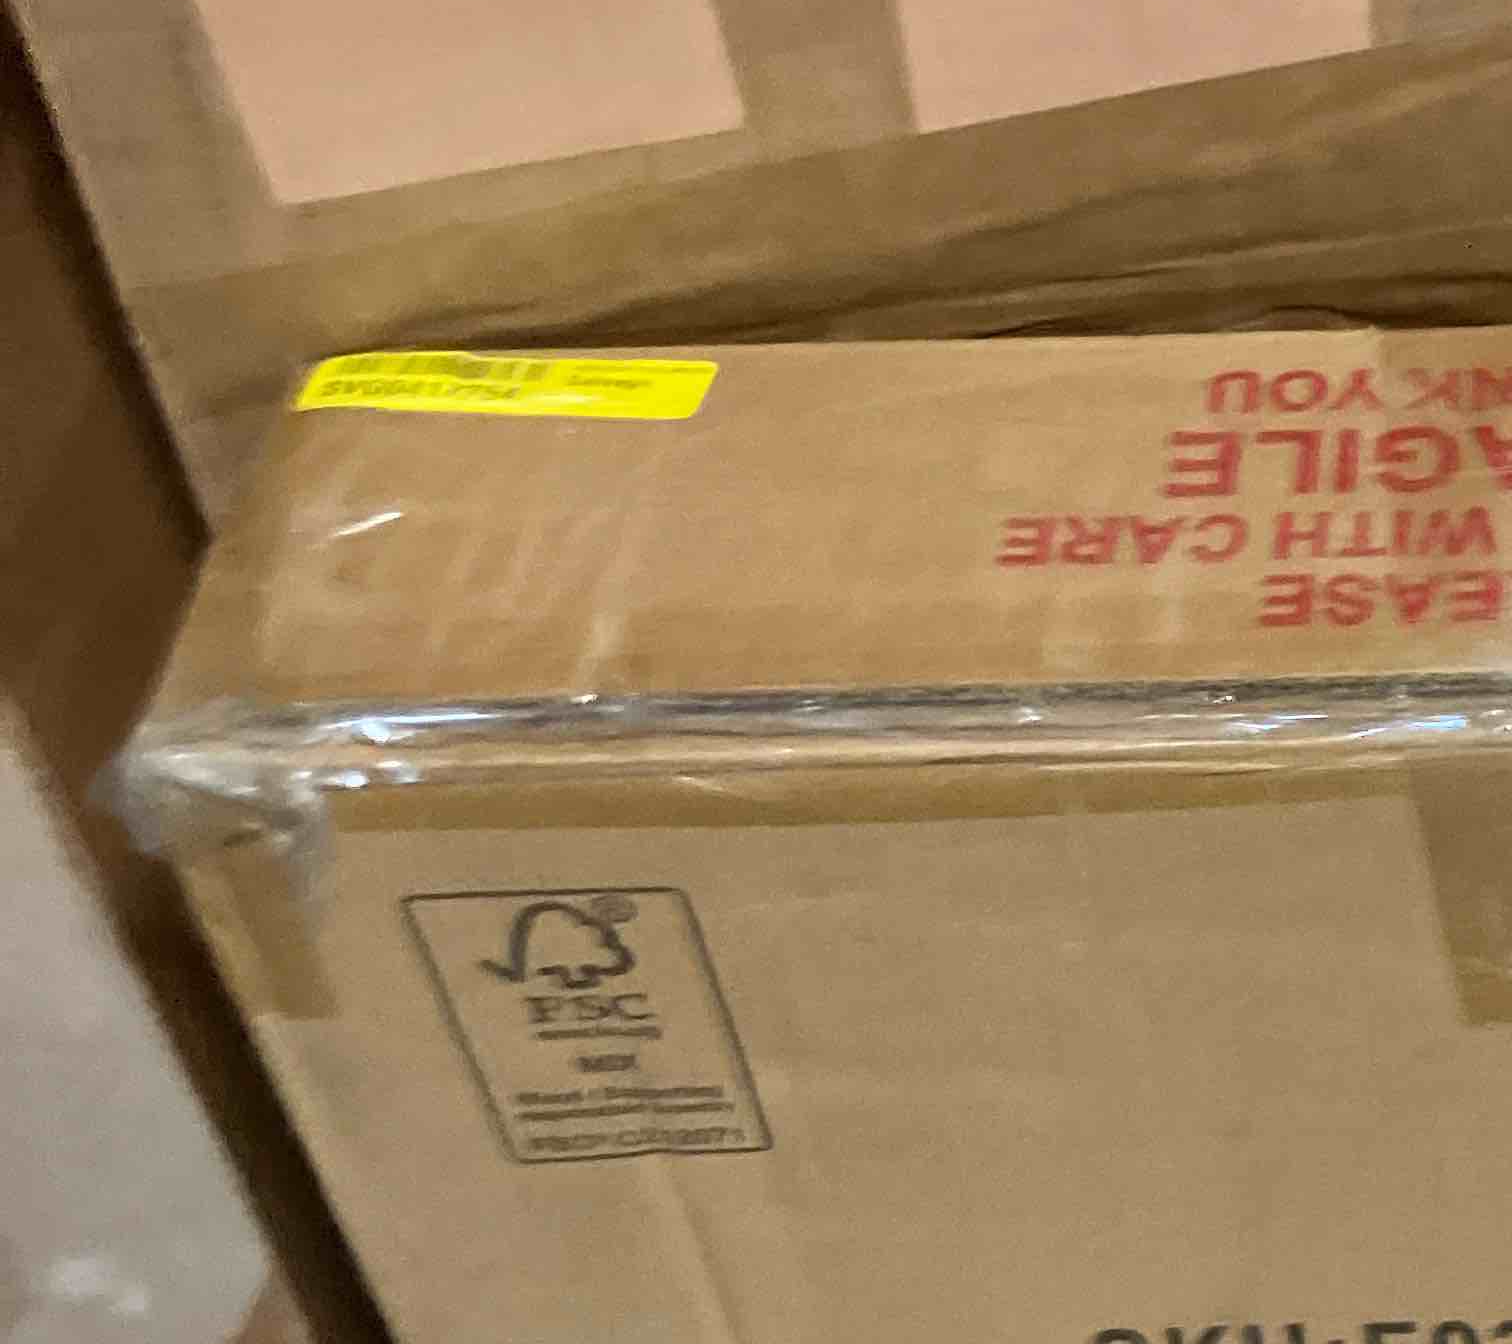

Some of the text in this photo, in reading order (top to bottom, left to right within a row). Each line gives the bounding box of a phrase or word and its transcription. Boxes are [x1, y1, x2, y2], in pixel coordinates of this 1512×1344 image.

[1206, 367, 1384, 414] YOU
[998, 511, 1252, 566] CARE
[1272, 505, 1497, 559] WITH
